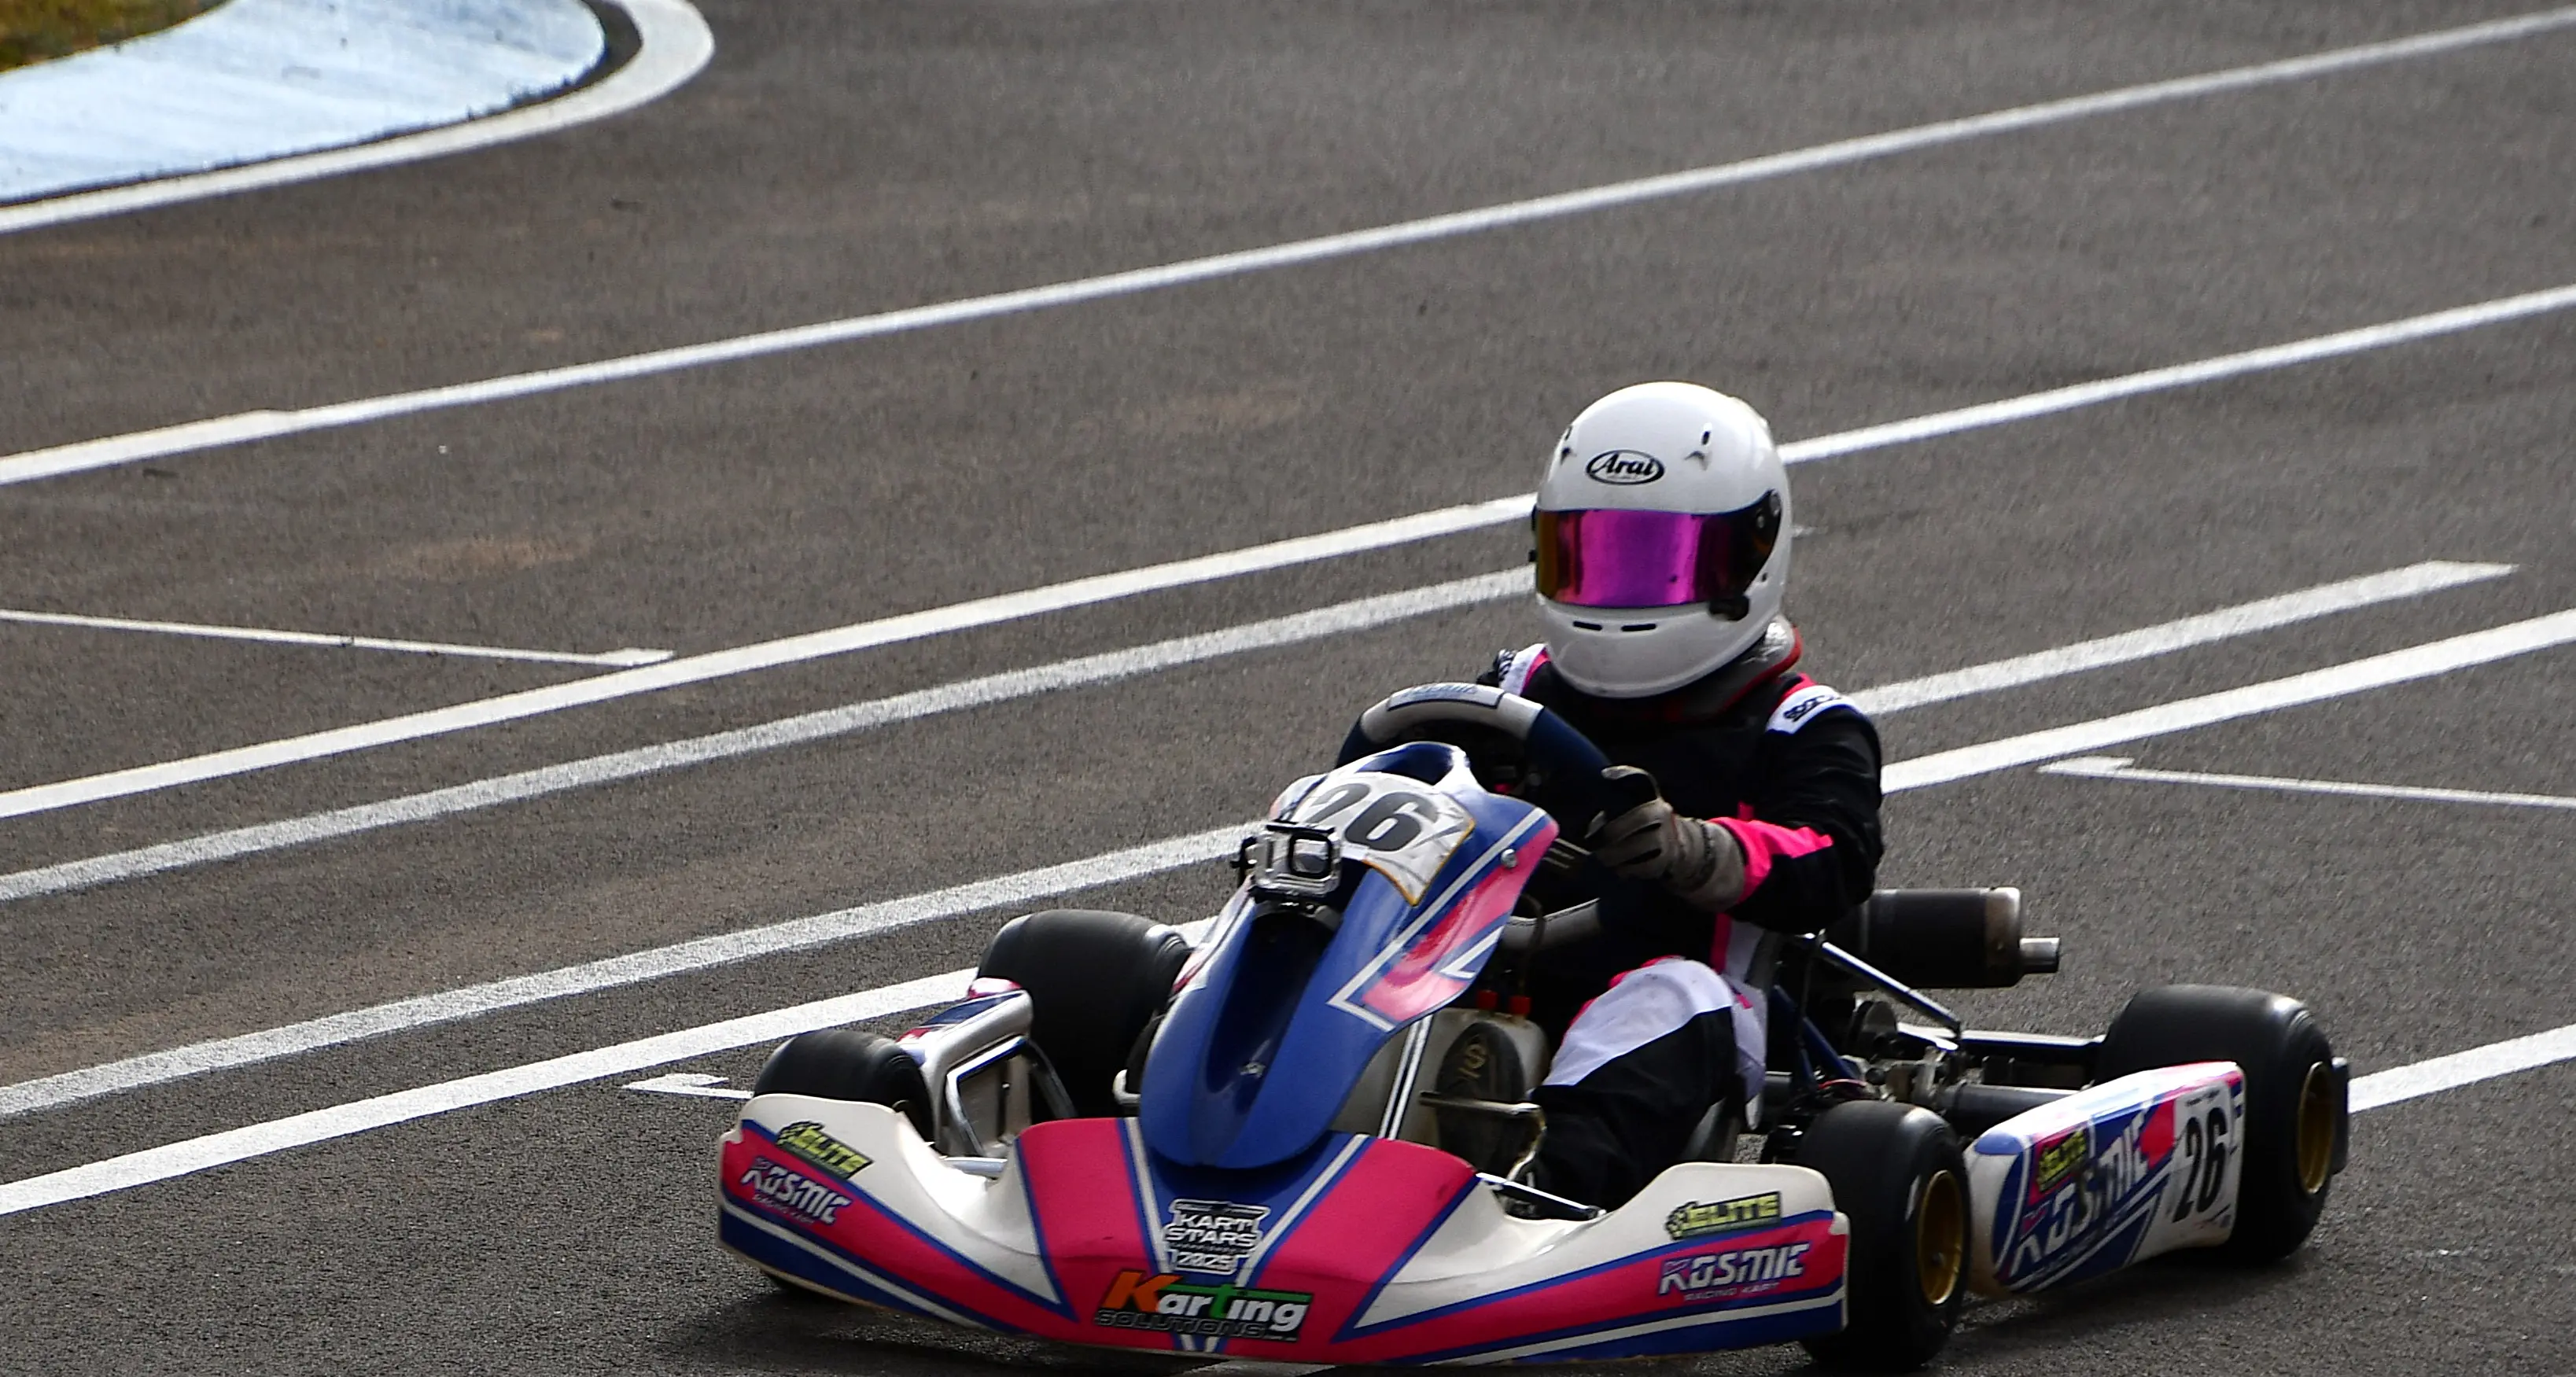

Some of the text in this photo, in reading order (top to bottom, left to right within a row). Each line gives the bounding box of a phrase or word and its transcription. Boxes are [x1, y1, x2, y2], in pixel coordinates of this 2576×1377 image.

[1591, 453, 1655, 476] Arai
[1305, 782, 1439, 852] 26
[790, 1127, 872, 1174] ELITE
[2172, 1107, 2228, 1223] 26
[741, 1157, 852, 1224] KOSMIC
[1682, 1194, 1778, 1232] ELITE
[1166, 1226, 1257, 1247] STARS
[1179, 1213, 1255, 1231] KART
[1658, 1243, 1810, 1295] KOSMIC
[1093, 1309, 1266, 1339] SOLUTIONS
[1100, 1271, 1308, 1332] Karting
